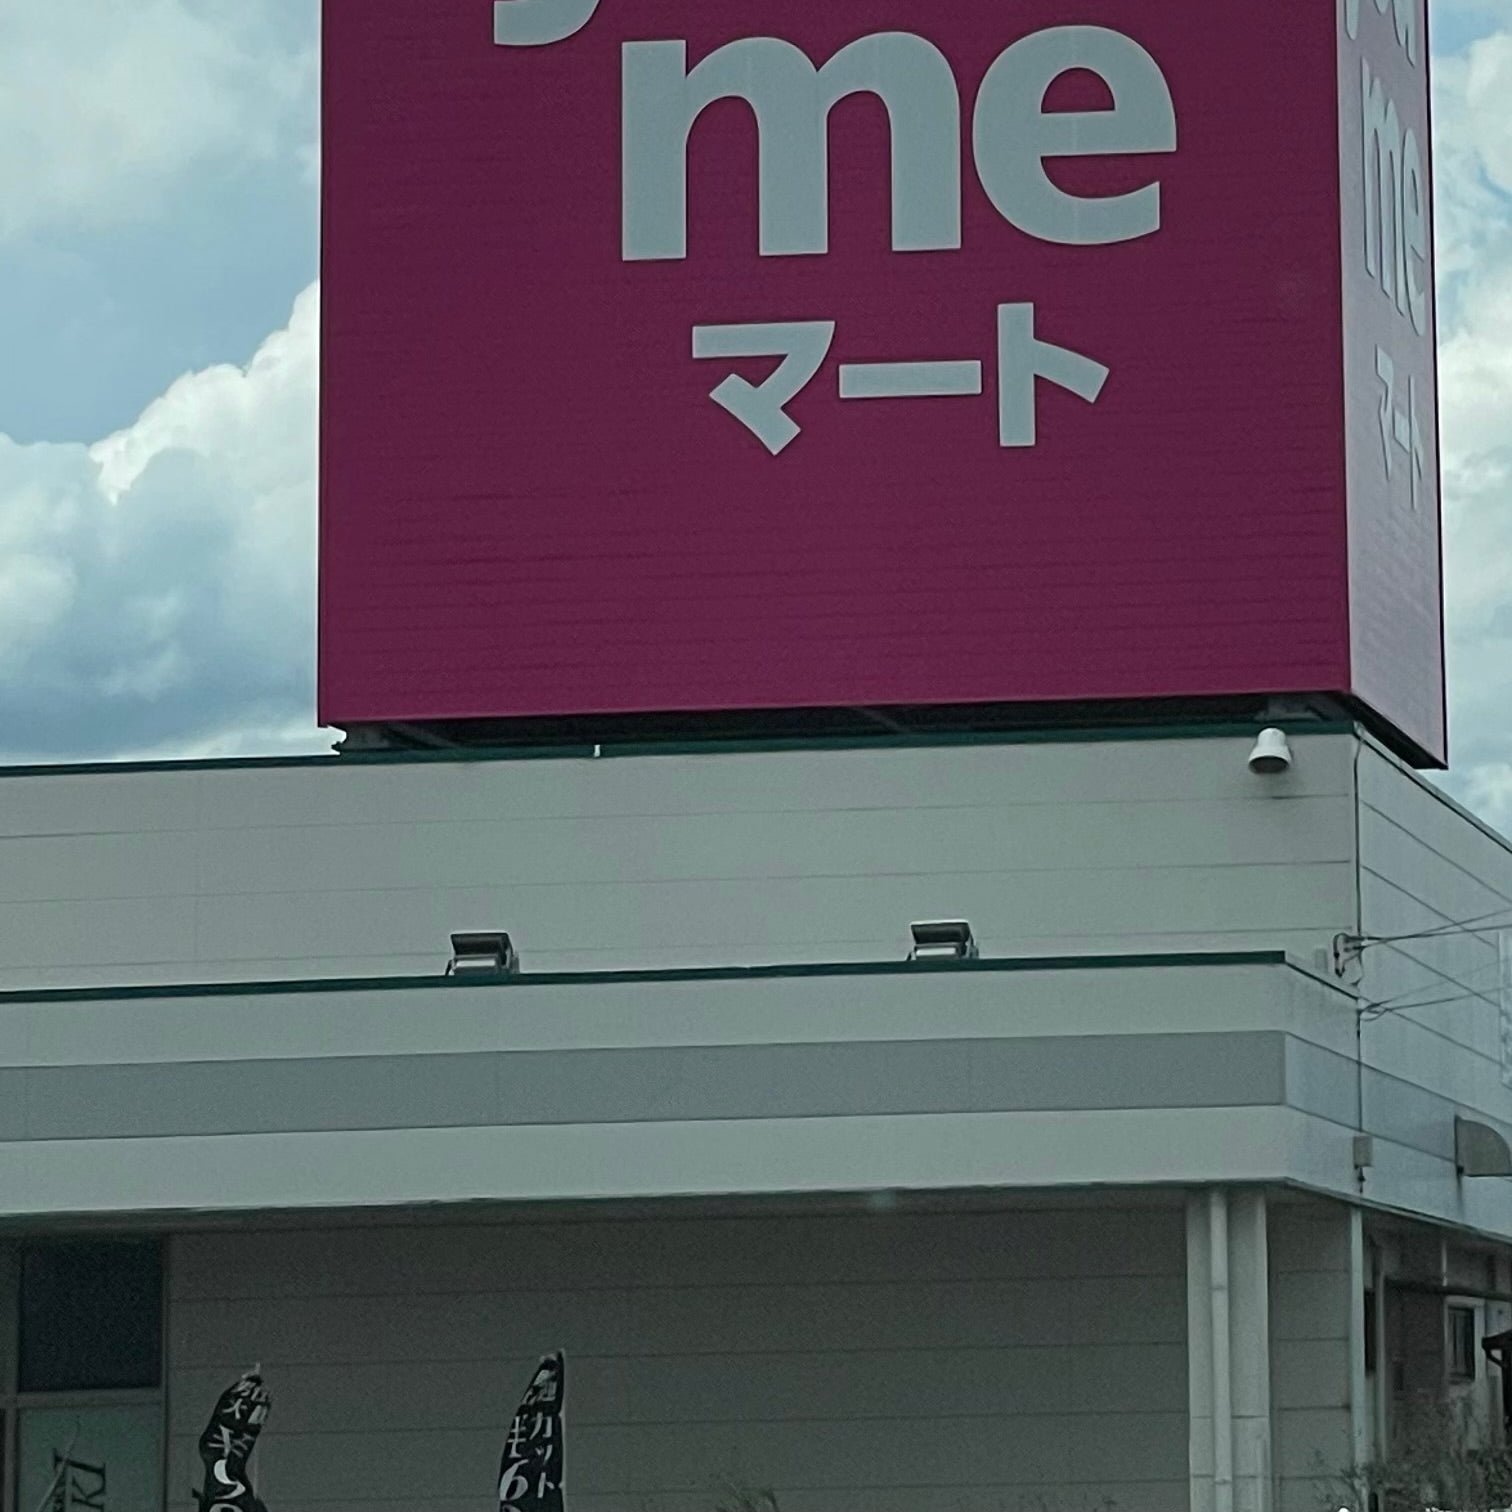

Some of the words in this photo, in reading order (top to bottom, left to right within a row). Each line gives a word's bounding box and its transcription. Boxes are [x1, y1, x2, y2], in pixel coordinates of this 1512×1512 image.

[621, 24, 1178, 262] me
[1360, 55, 1426, 337] me
[692, 301, 1110, 456] マート
[1374, 344, 1423, 511] マート
